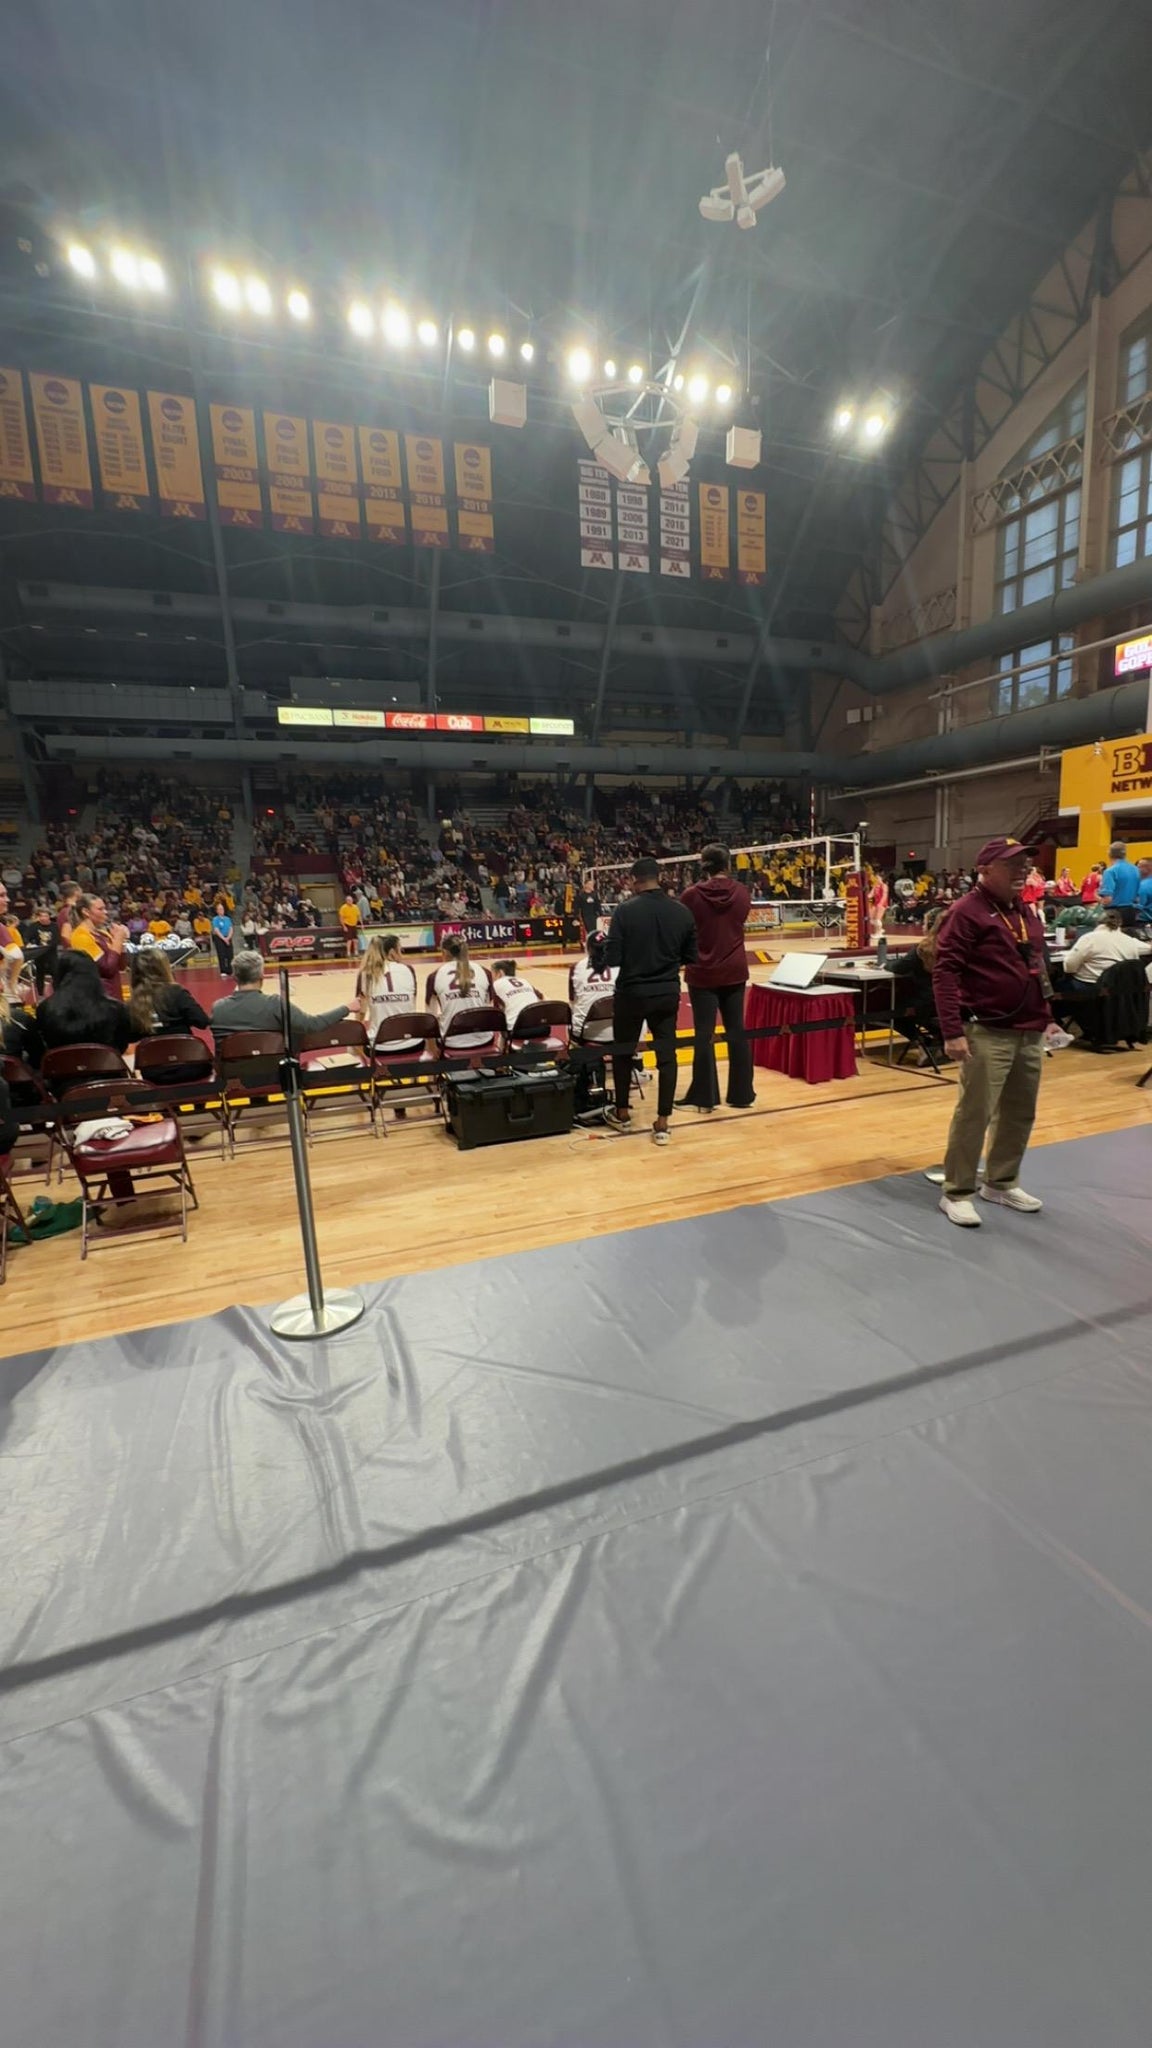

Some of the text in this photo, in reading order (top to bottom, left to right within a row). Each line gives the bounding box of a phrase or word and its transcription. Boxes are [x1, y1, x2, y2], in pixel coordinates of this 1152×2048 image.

[370, 486, 397, 499] 2015
[463, 499, 488, 512] 2019
[664, 501, 685, 513] 2014
[585, 507, 607, 518] 1989
[586, 525, 607, 536] 1991
[623, 530, 644, 541] 2013
[665, 536, 684, 547] 2021
[590, 552, 606, 565] M
[626, 556, 642, 568] M
[668, 562, 683, 573] M
[447, 716, 472, 731] Cub
[484, 924, 513, 941] LAKE
[384, 971, 394, 992] 1
[508, 978, 523, 988] 6
